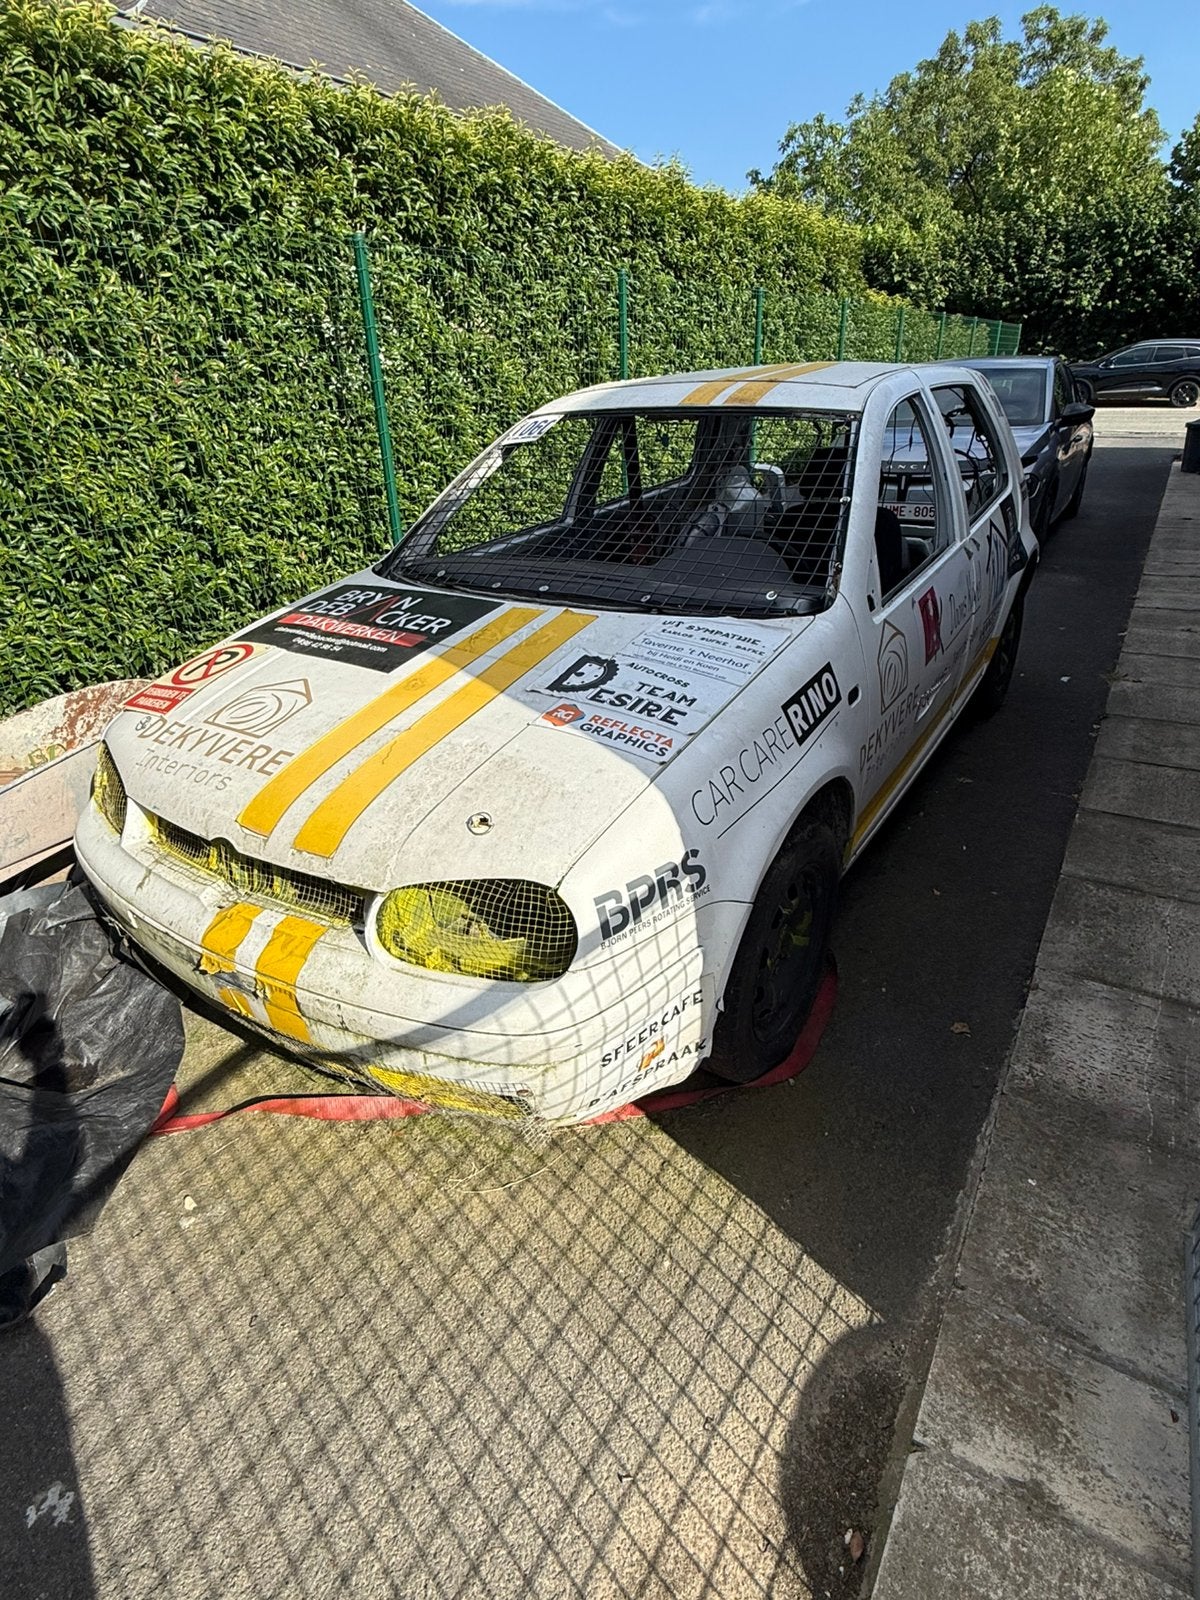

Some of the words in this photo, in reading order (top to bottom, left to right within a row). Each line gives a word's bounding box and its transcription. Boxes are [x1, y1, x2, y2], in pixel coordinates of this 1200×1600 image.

[294, 615, 404, 643] DAKWERKEN
[641, 637, 684, 653] Taverne
[697, 650, 750, 669] Neerhof
[659, 652, 683, 662] Heidi
[696, 661, 720, 671] Koen
[545, 654, 688, 727] DESIRE
[628, 661, 691, 689] AUTOCROSS
[636, 681, 698, 708] TEAM
[787, 672, 837, 738] RINO
[137, 716, 295, 777] DEKYVERE
[579, 723, 669, 757] GRAPHICS
[589, 714, 674, 749] REFLECTA
[135, 748, 232, 791] Interiors
[593, 848, 707, 941] BPRS
[628, 919, 652, 937] PEERS
[653, 900, 686, 924] ROTATING
[686, 883, 711, 906] SERVICE
